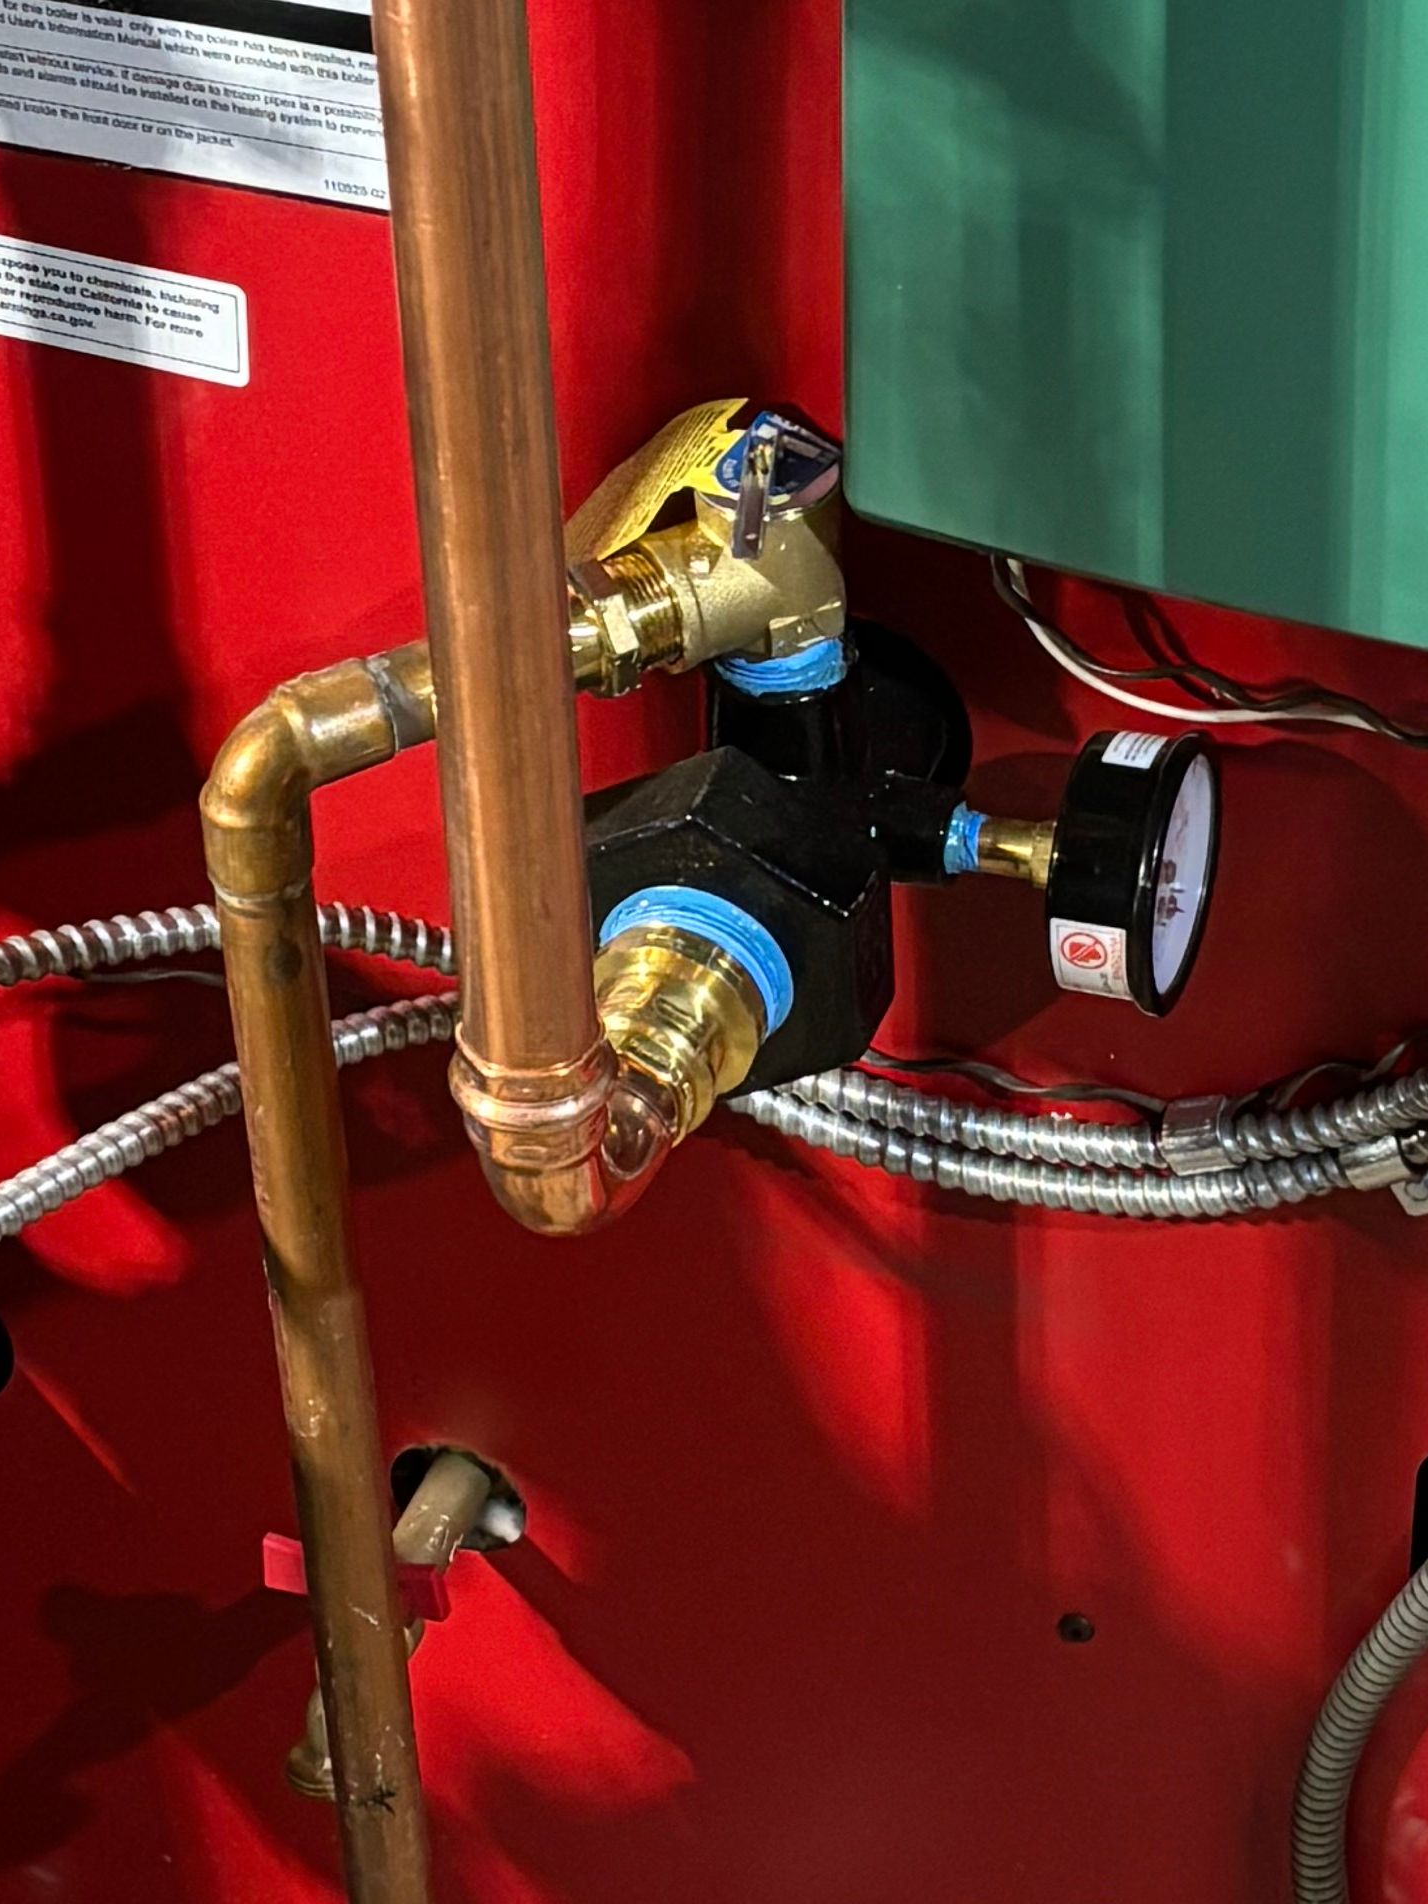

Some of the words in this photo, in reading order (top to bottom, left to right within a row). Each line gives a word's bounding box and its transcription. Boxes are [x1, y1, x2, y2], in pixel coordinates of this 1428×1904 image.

[4, 270, 24, 283] the
[28, 275, 59, 291] state
[63, 283, 75, 295] of
[80, 287, 142, 309] California
[145, 301, 158, 313] to
[162, 307, 201, 322] cause
[42, 266, 66, 281] you
[70, 270, 82, 282] to
[86, 274, 154, 300] chemicals,
[19, 288, 100, 317] reproductive
[104, 307, 138, 323] harm.
[145, 316, 165, 329] For
[170, 323, 202, 337] more
